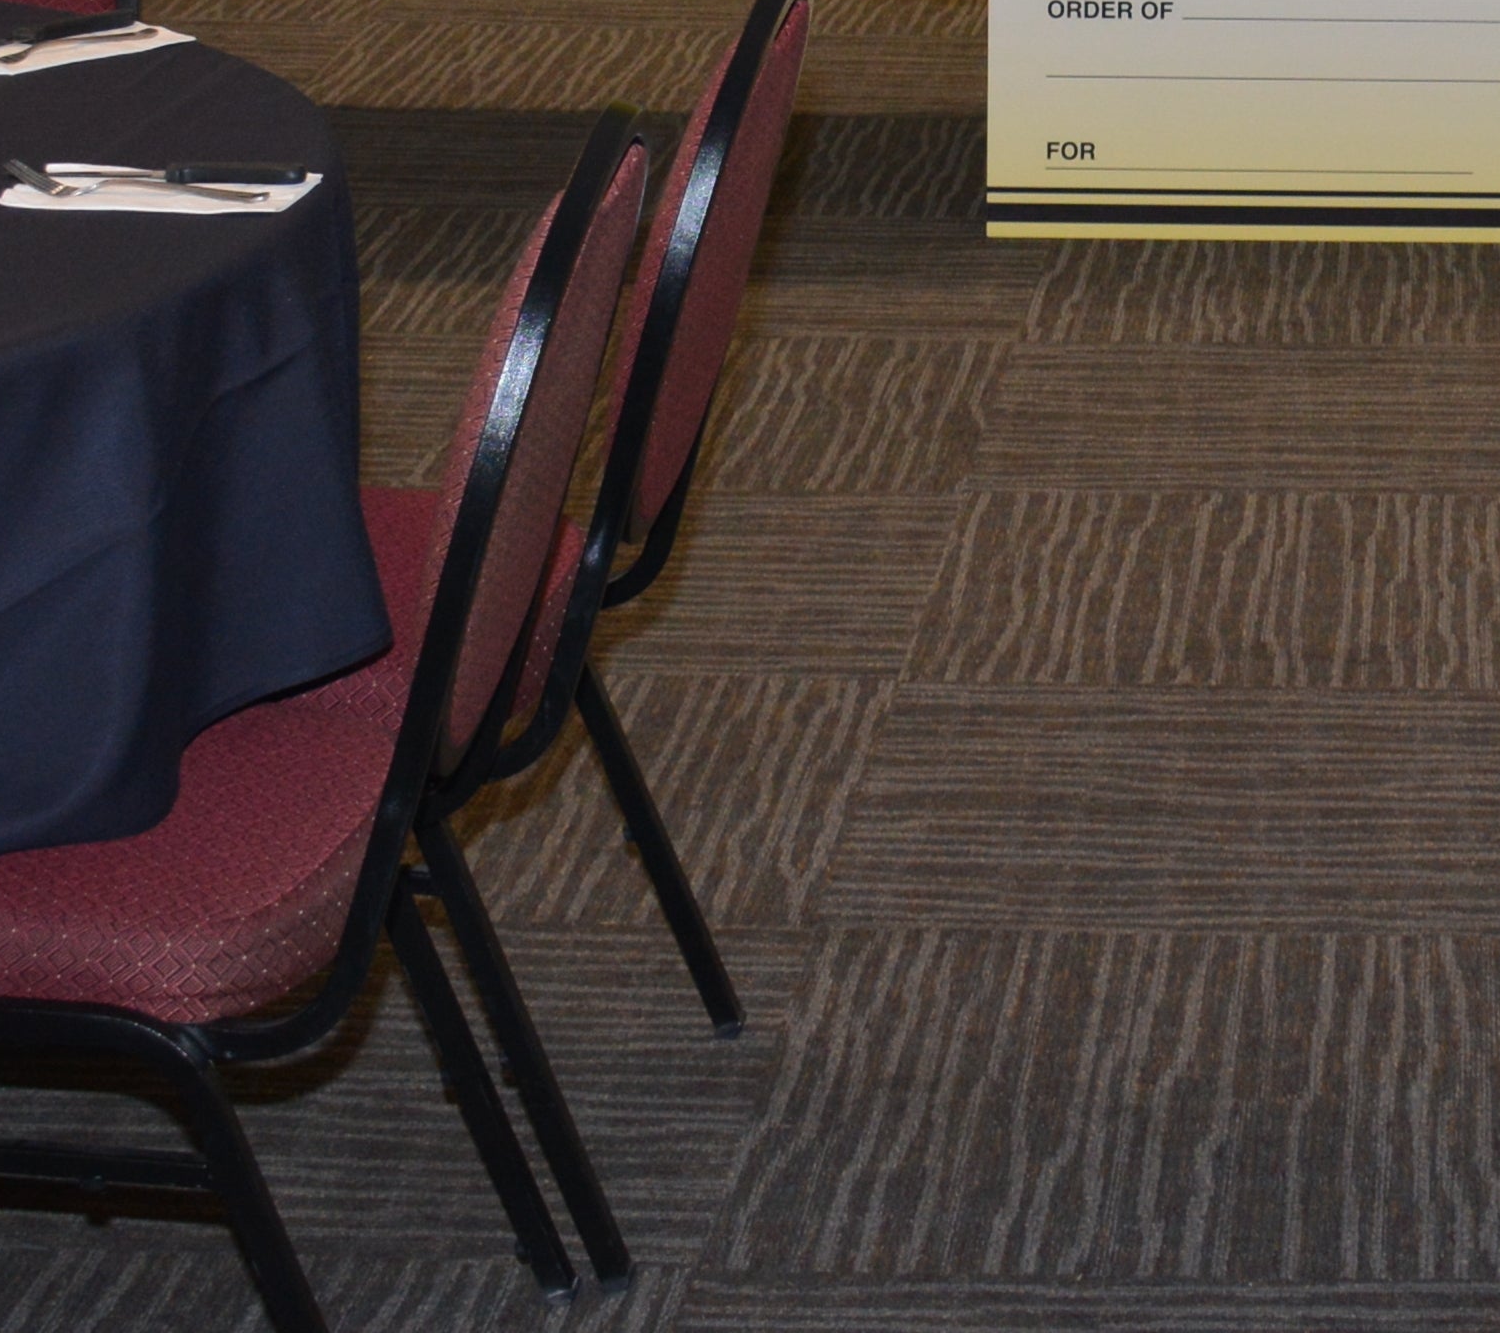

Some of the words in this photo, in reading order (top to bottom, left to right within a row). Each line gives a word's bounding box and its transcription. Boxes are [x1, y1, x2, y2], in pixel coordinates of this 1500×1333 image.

[1048, 1, 1133, 19] ORDER
[1141, 2, 1173, 19] OF
[1047, 142, 1096, 160] FOR
